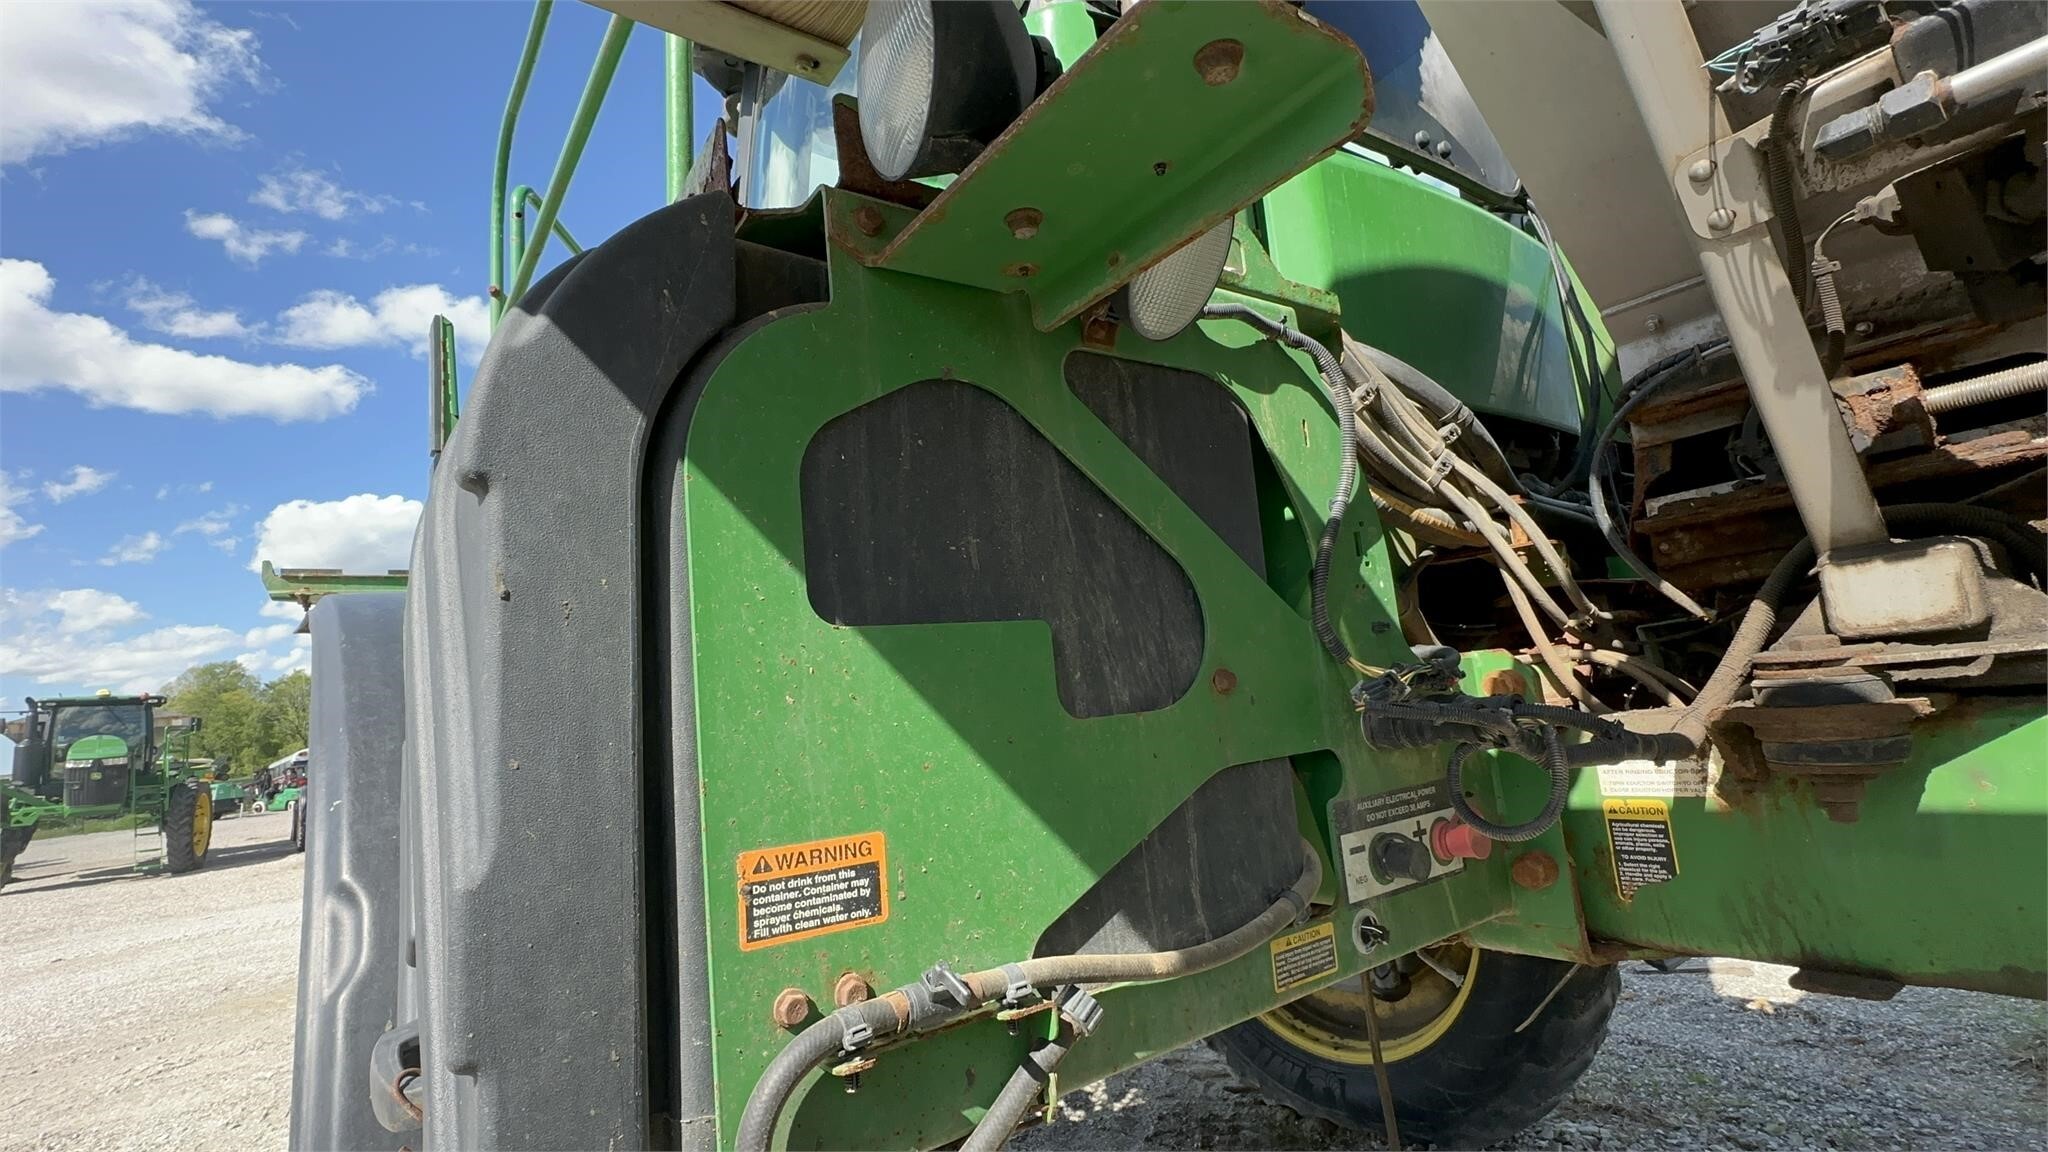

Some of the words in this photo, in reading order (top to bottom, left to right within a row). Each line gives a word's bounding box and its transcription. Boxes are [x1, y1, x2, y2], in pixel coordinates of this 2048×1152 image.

[1357, 798, 1384, 811] AUXILIARY
[1386, 790, 1417, 804] ELECTRICAL
[1417, 786, 1436, 796] POWER
[1366, 813, 1375, 822] DO
[1376, 810, 1387, 820] NOT
[1388, 805, 1409, 817] EXCEED
[1416, 800, 1431, 809] AMPS
[1619, 807, 1664, 815] CAUTION
[775, 841, 872, 870] WARNING
[752, 885, 767, 895] Do
[769, 882, 786, 892] not
[787, 876, 813, 889] drink
[814, 872, 836, 884] from
[839, 869, 856, 879] this
[752, 892, 801, 906] container.
[803, 881, 849, 896] Container
[851, 878, 870, 889] may
[1355, 875, 1369, 884] NEG
[753, 904, 792, 917] become
[794, 889, 858, 908] contaminated
[860, 888, 871, 898] by
[753, 914, 791, 929] sprayer
[793, 903, 843, 920] chemicals.
[754, 928, 769, 939] Fill
[771, 923, 793, 935] with
[795, 917, 820, 930] clean
[822, 913, 848, 924] water
[850, 908, 872, 919] only.
[1293, 928, 1321, 944] CAUTION
